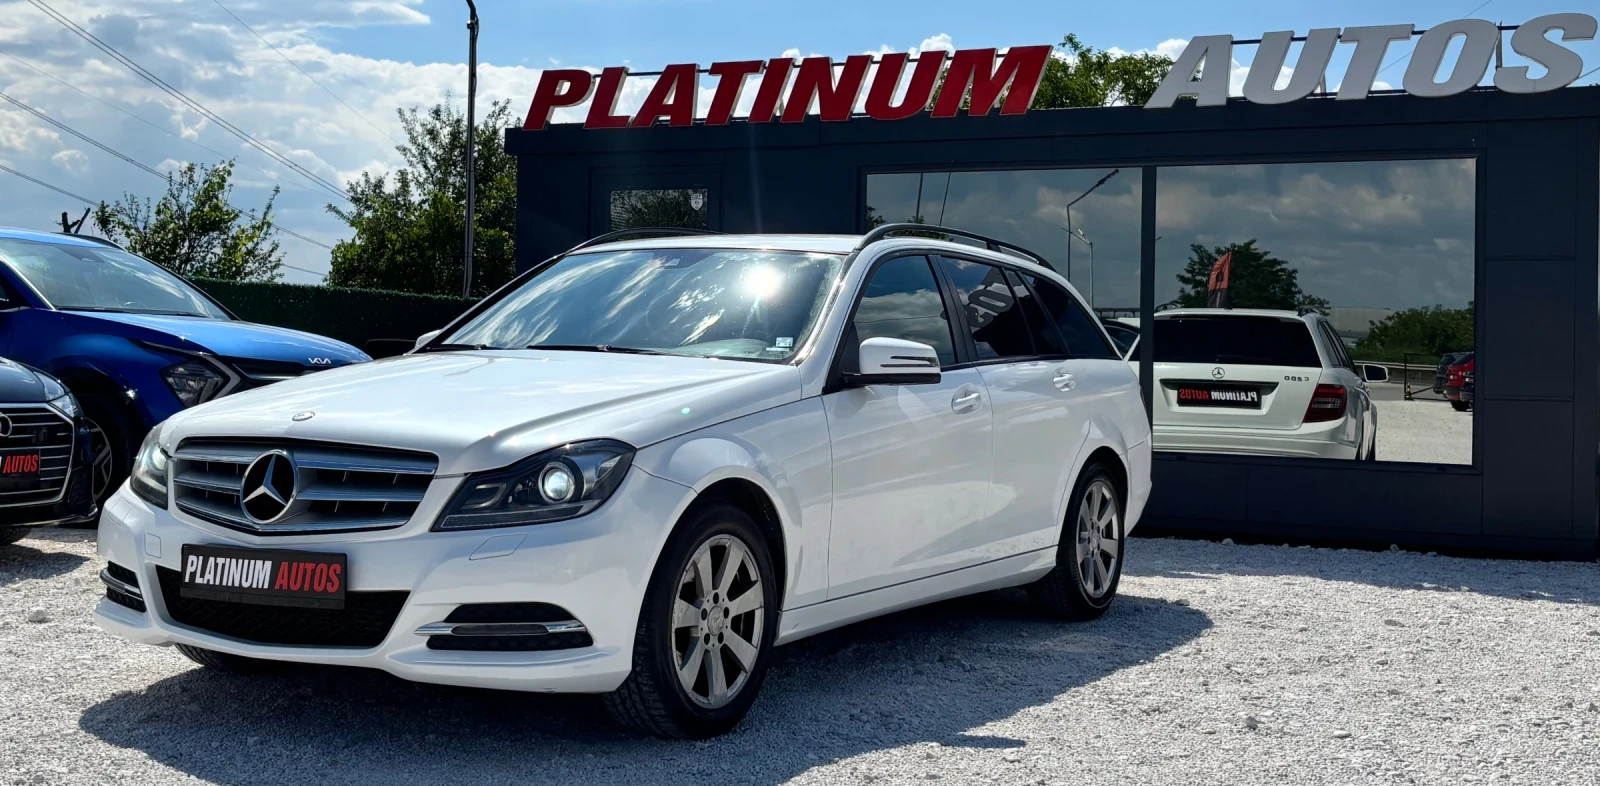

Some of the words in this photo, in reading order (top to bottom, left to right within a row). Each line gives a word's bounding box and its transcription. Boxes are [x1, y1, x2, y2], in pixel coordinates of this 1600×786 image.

[522, 44, 1053, 131] PLATINUM
[1143, 12, 1599, 109] AUTOS
[2, 454, 39, 474] AUTOS
[184, 554, 273, 589] PLATINUM
[274, 561, 342, 593] AUTOS
